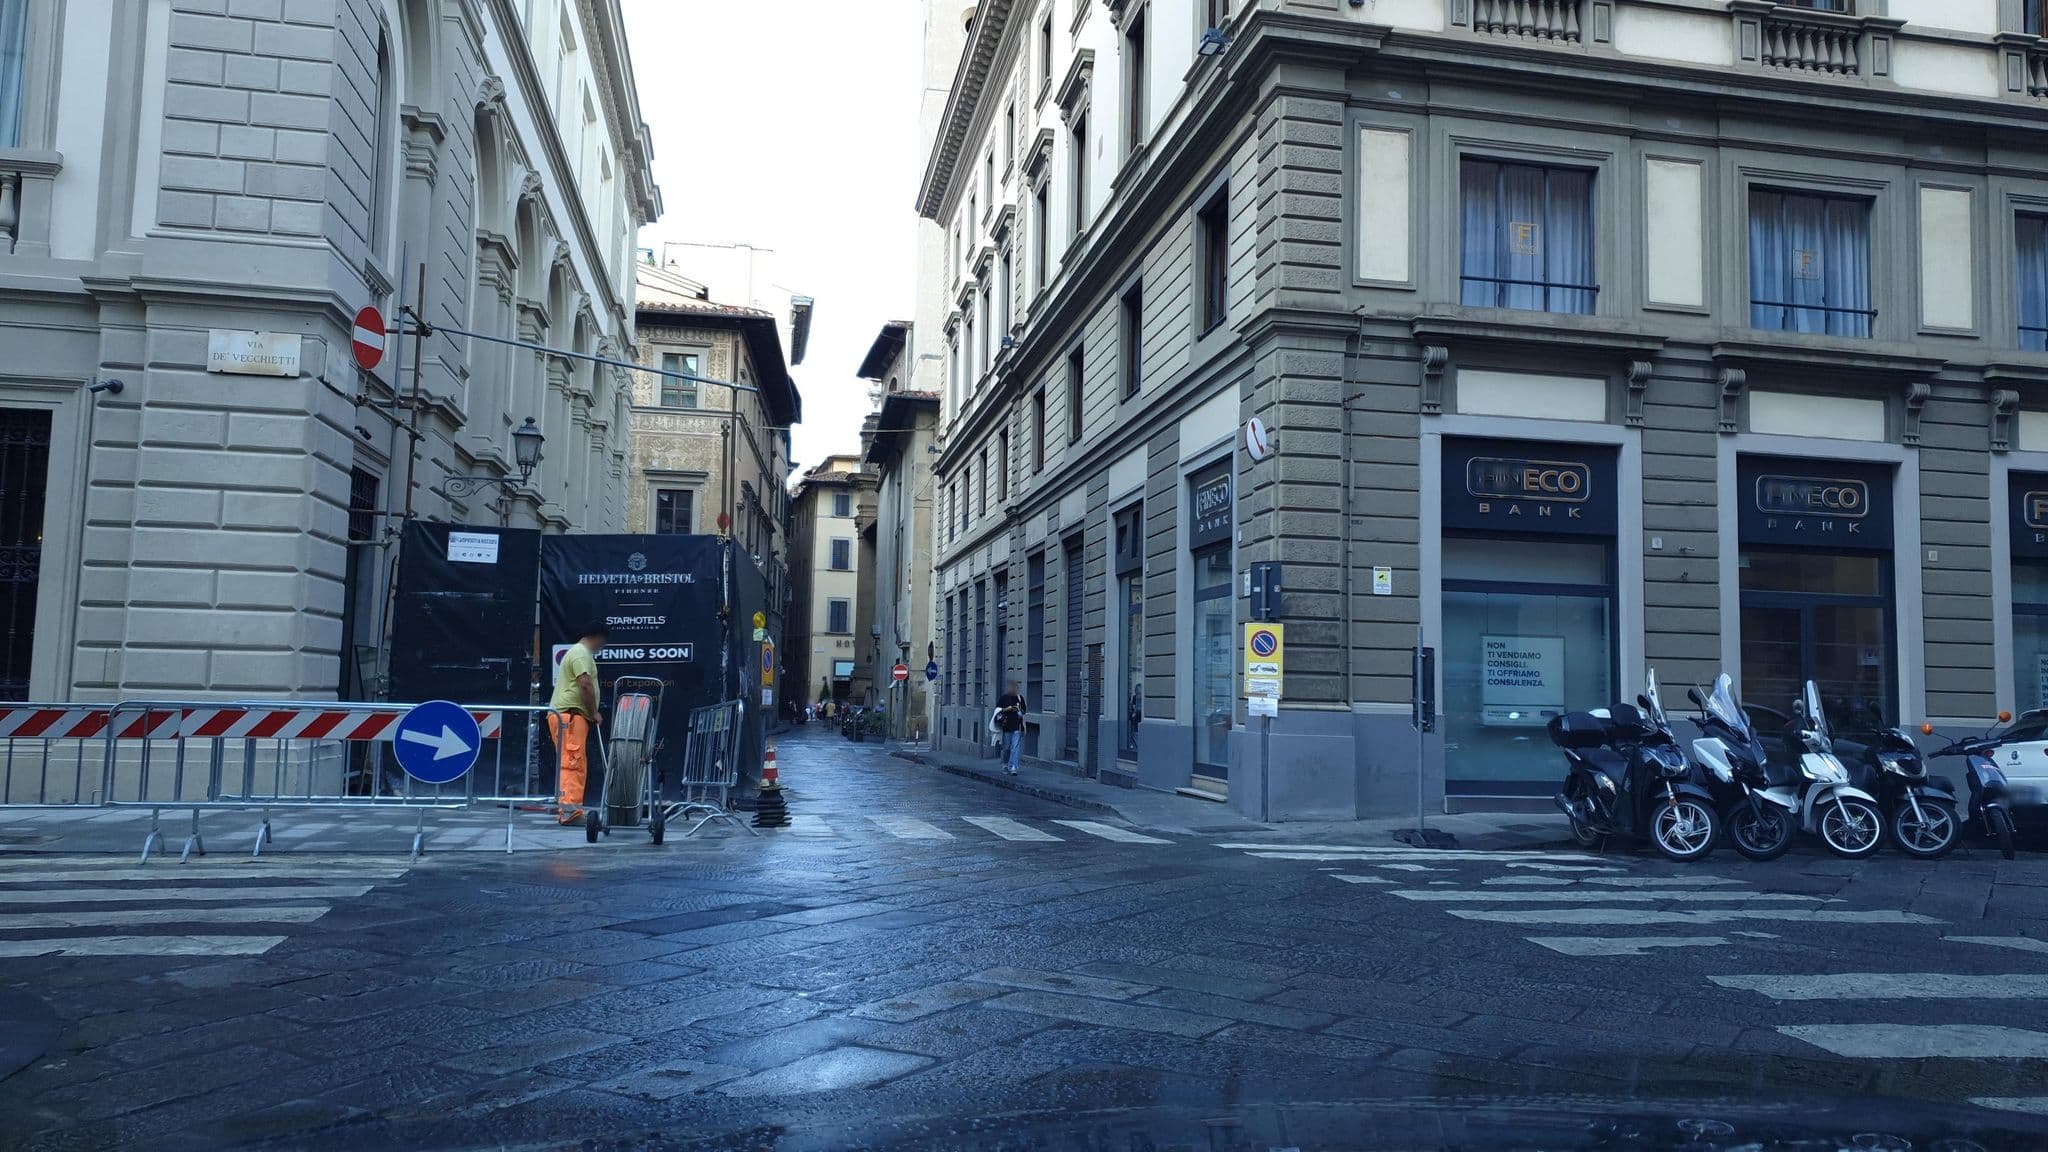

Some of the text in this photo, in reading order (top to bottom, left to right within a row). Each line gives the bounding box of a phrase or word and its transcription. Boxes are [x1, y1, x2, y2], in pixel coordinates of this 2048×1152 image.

[247, 341, 264, 349] VIA
[233, 353, 295, 365] VECCHIETTI
[1479, 503, 1581, 518] BANK
[1768, 519, 1860, 533] BANK
[606, 616, 667, 625] STARHOTELS
[594, 647, 689, 659] PENING SOON
[1496, 651, 1542, 659] VENDIAMO
[1497, 669, 1541, 677] OFFRIAMO
[628, 679, 674, 690] Expanson
